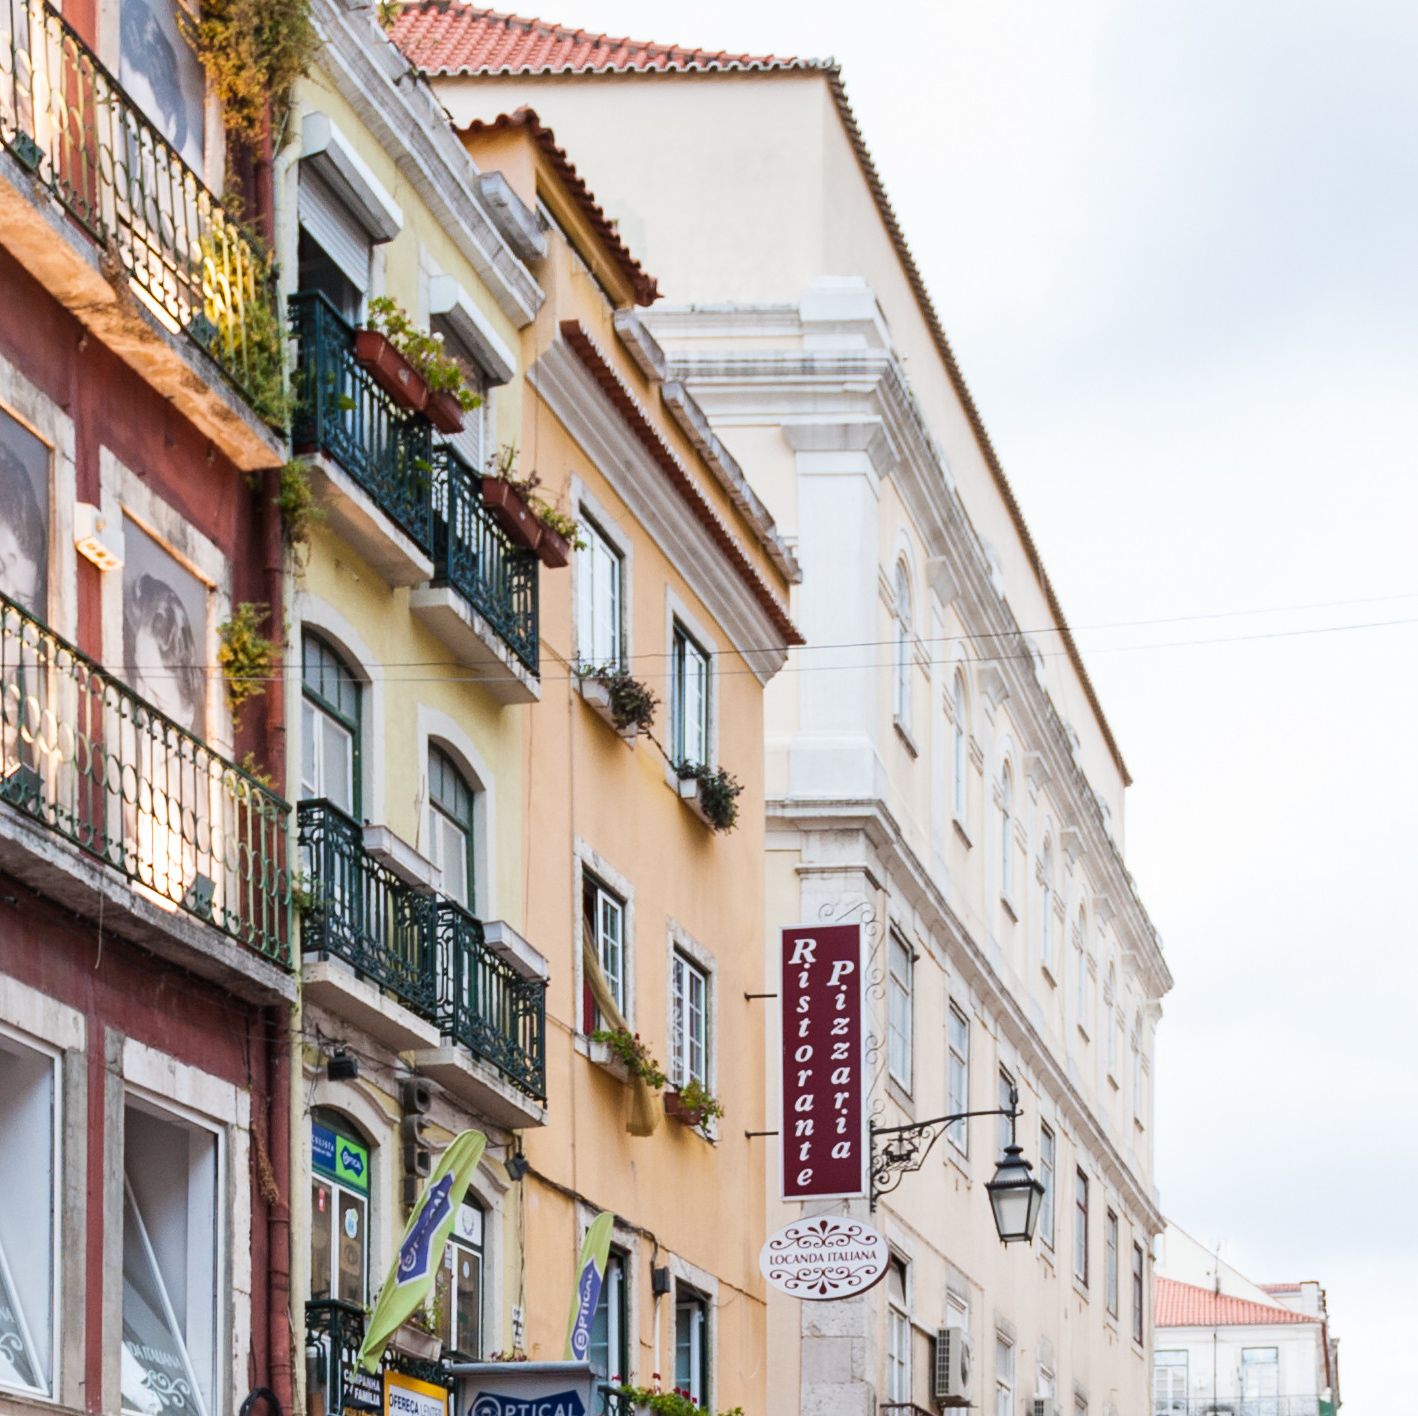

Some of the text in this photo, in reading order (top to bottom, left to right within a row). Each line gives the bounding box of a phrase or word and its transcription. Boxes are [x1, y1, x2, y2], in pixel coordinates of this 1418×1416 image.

[788, 938, 818, 1187] Ristorante
[826, 960, 855, 1160] Pizzaria
[769, 1248, 877, 1266] LOCANDA ITALIANA
[389, 1393, 419, 1416] OFEREÇA
